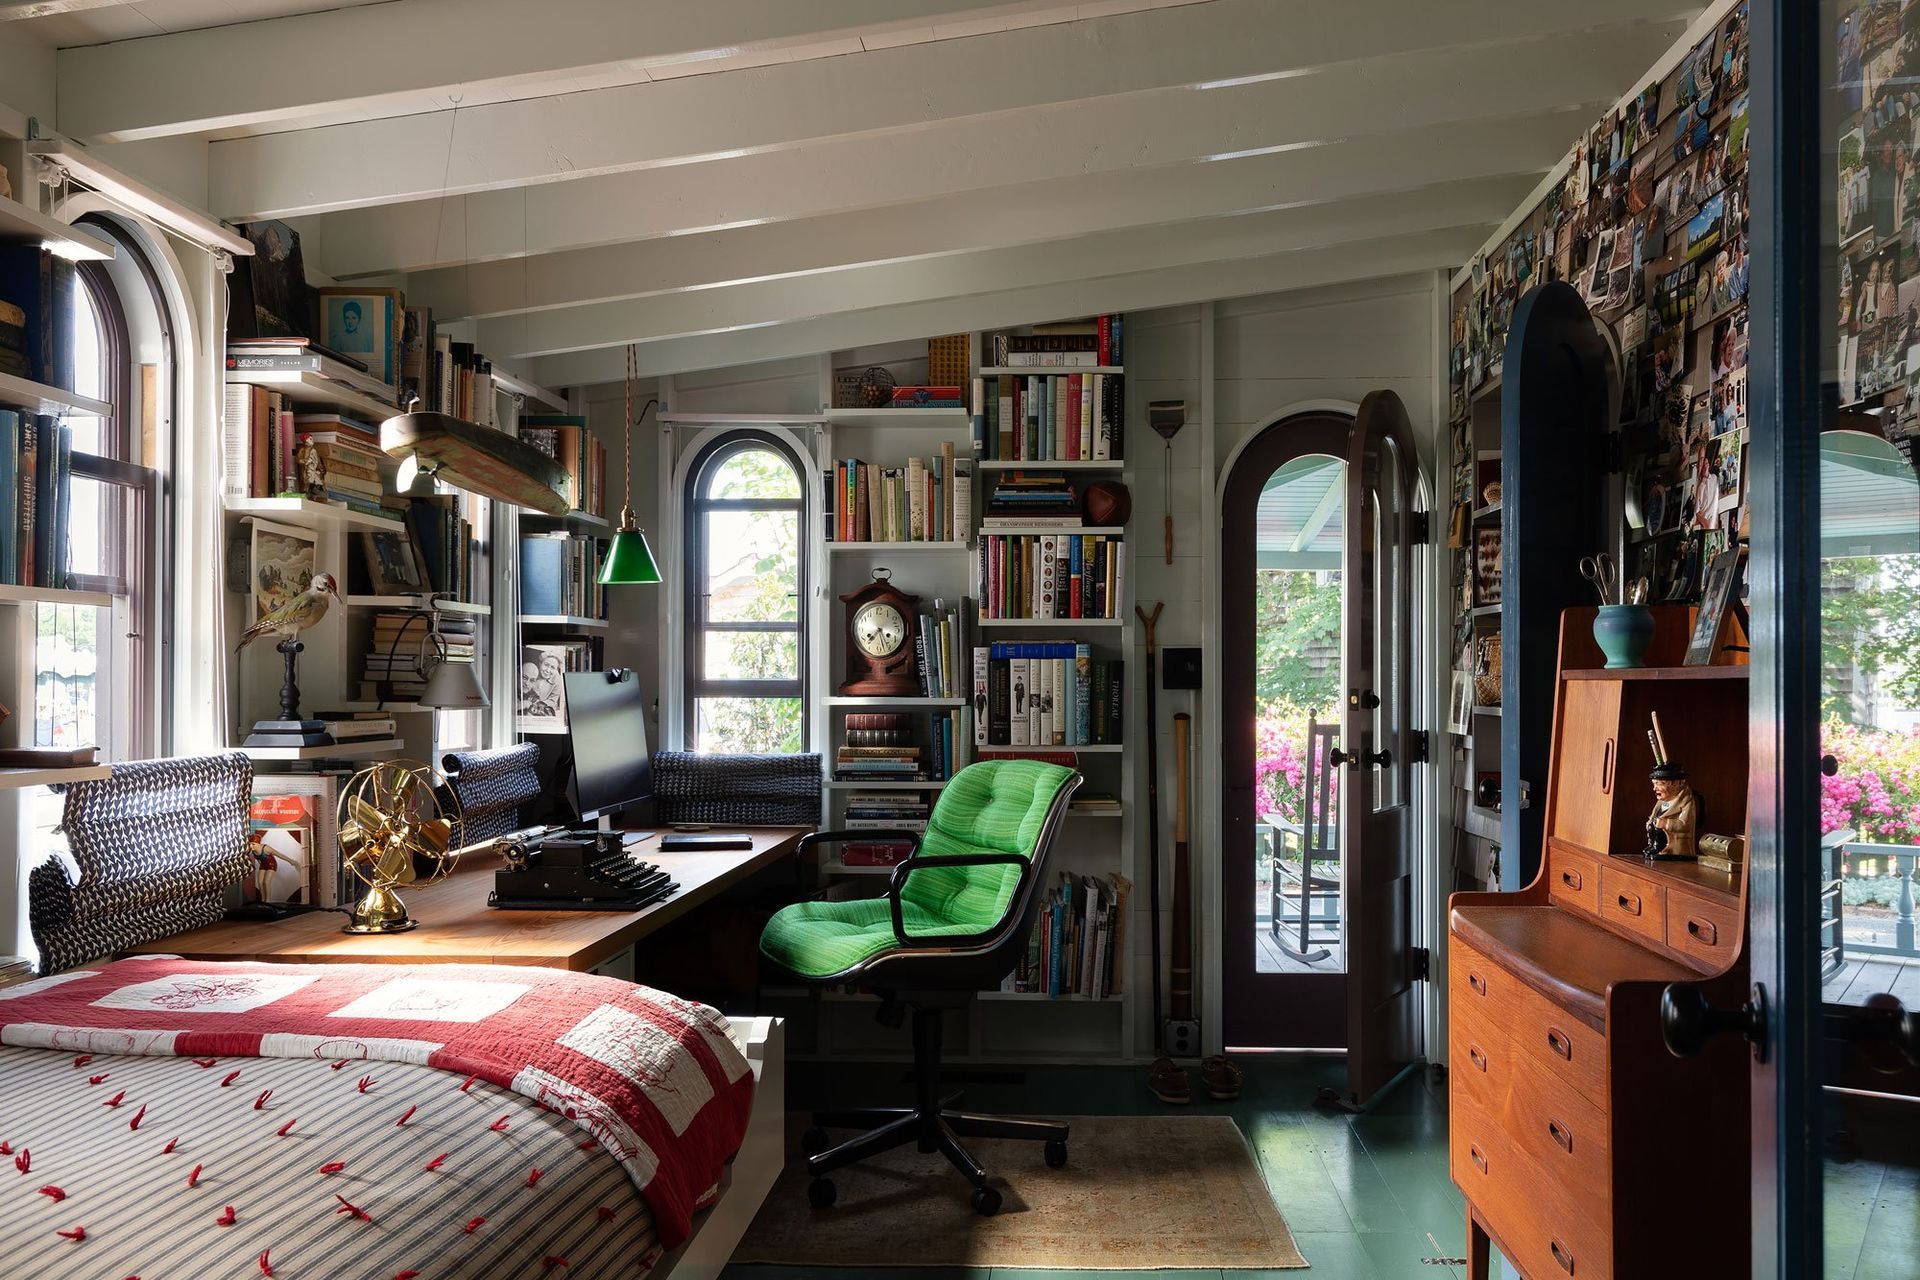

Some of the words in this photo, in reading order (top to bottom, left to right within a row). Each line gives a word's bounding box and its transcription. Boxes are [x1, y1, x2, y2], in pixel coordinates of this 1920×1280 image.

[1084, 551, 1095, 600] Mayflower
[876, 607, 882, 615] 12
[915, 635, 924, 658] TROUT
[918, 660, 926, 676] TIPS
[1112, 680, 1120, 720] THOREAU
